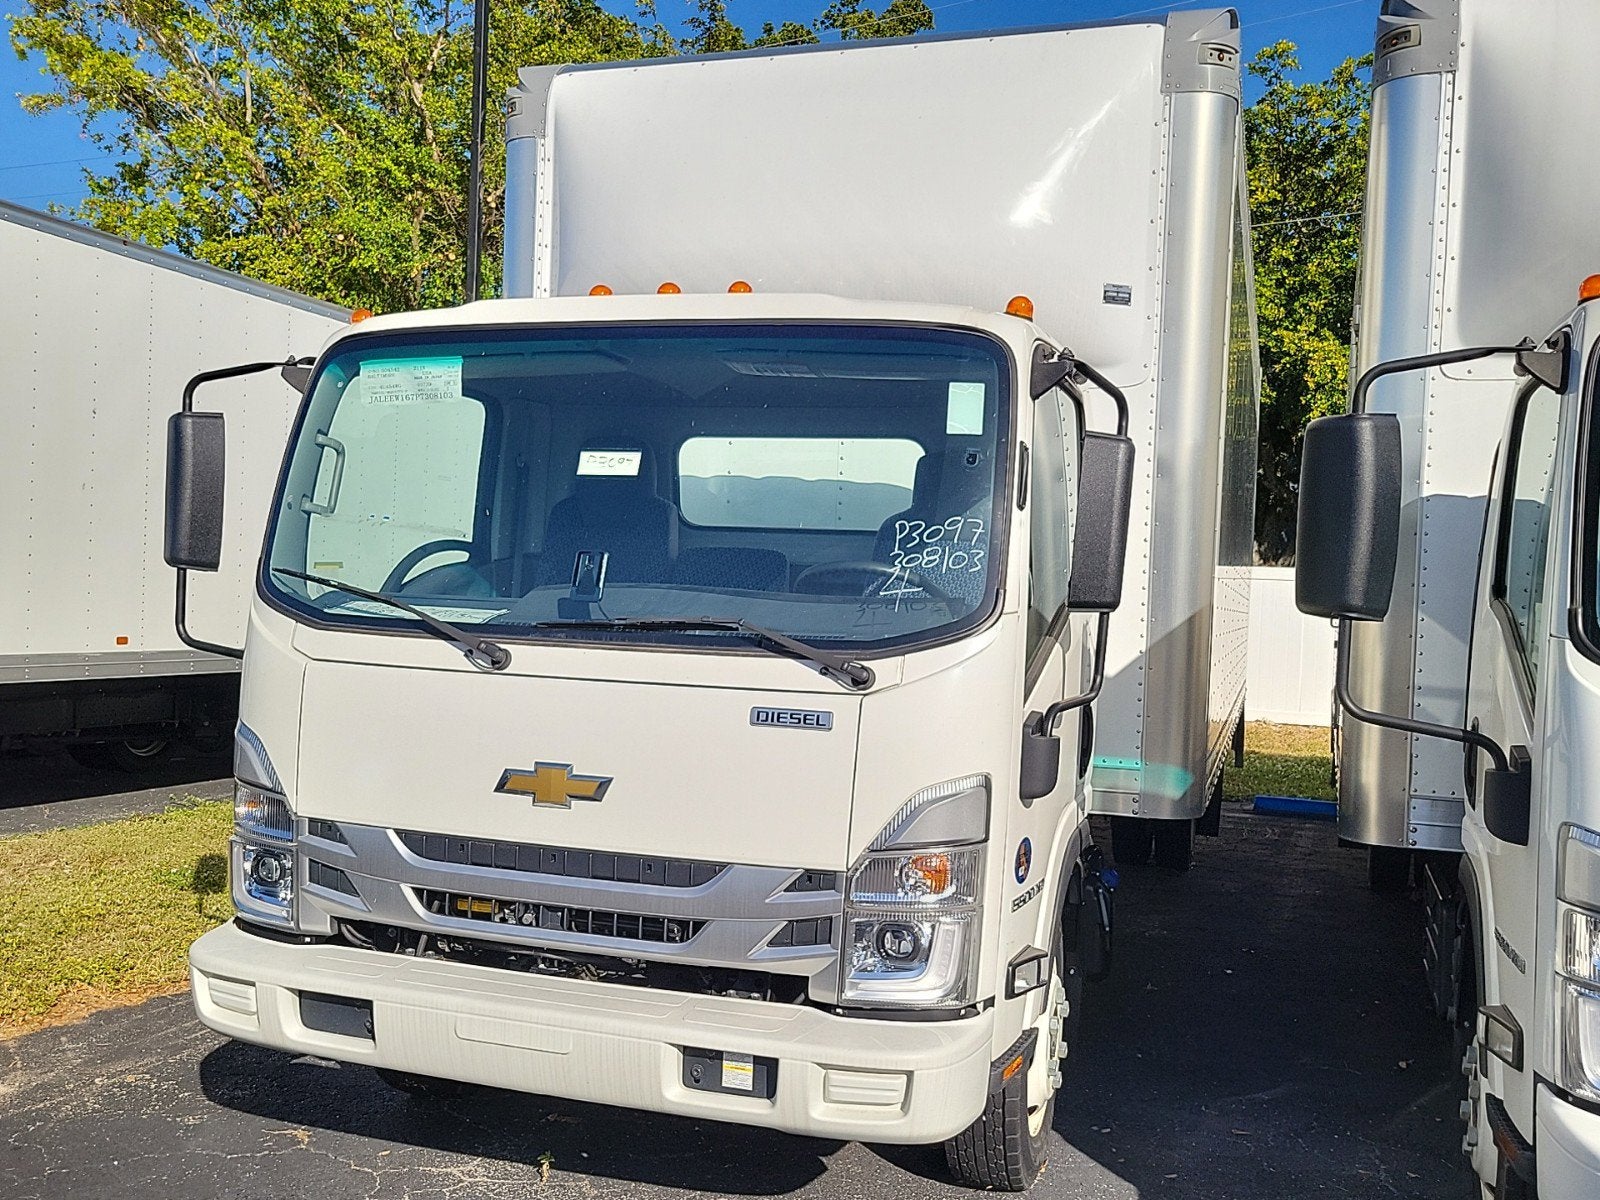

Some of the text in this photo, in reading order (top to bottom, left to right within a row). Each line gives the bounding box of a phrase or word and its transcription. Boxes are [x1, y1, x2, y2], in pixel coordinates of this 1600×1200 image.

[894, 516, 986, 552] P3097
[889, 546, 985, 573] 308103
[879, 568, 924, 613] 4
[755, 710, 827, 727] DIESEL
